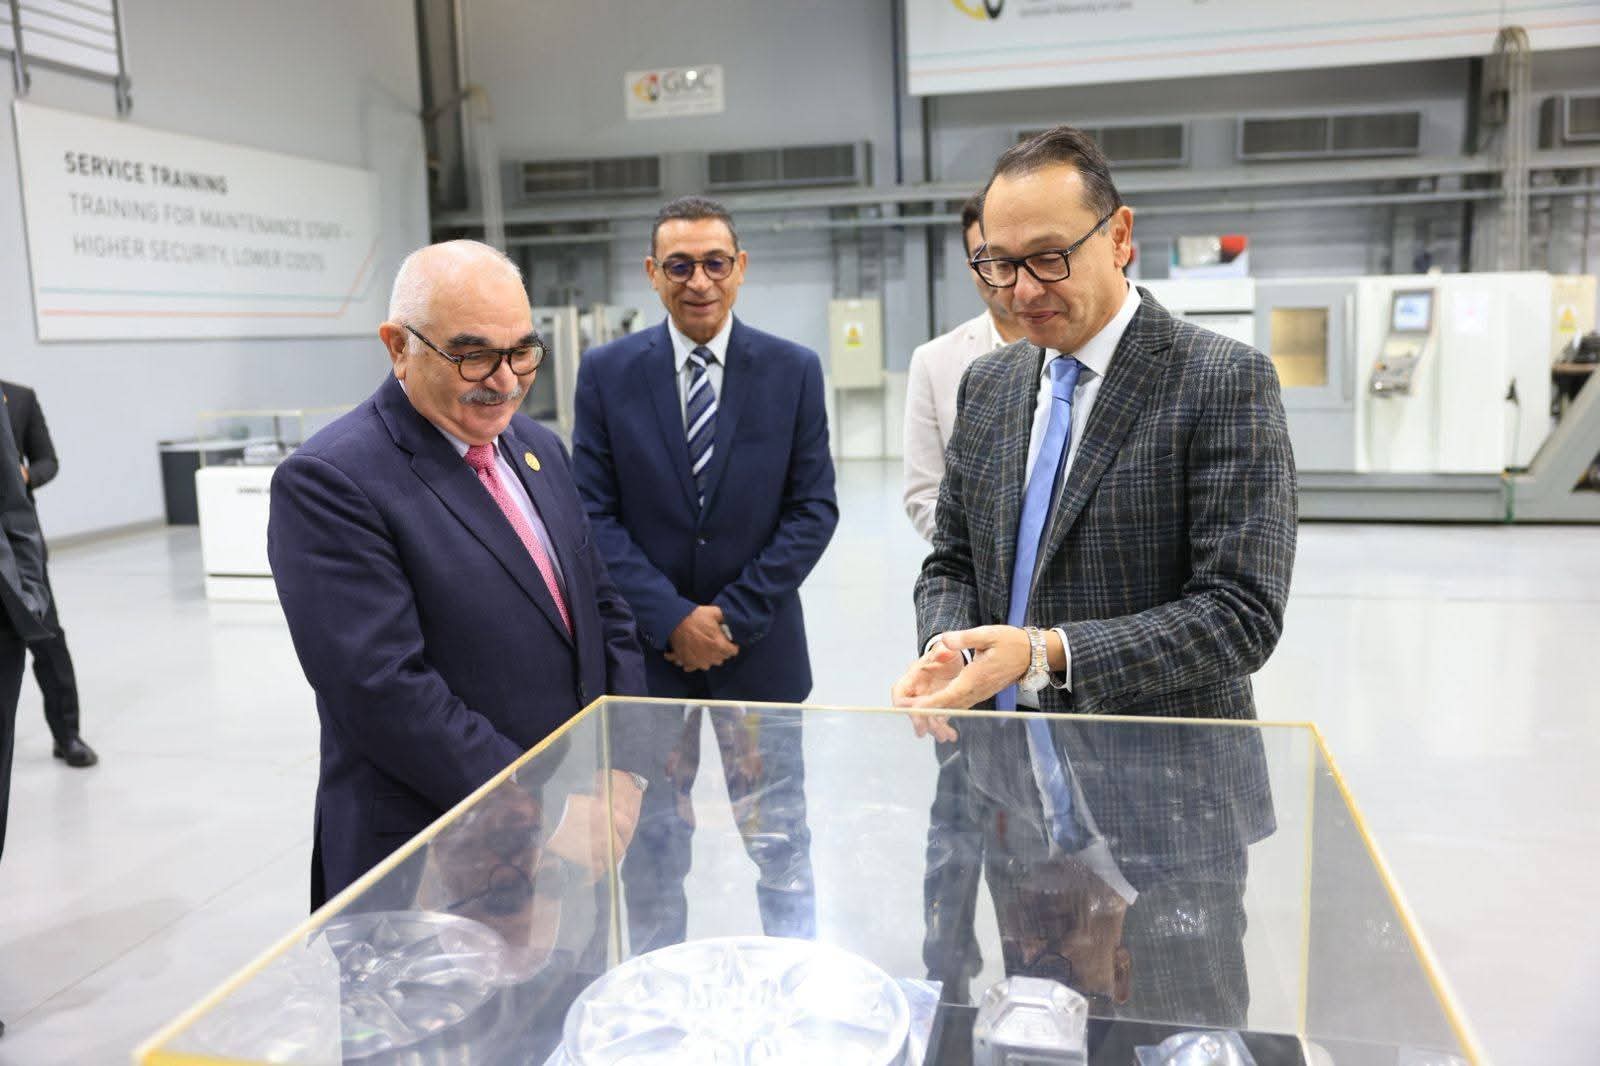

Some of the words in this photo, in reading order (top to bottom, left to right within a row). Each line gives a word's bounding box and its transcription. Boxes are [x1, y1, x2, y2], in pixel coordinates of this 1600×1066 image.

[64, 151, 145, 184] SERVICE
[150, 165, 229, 195] TRAINING
[70, 193, 159, 224] TRAINING
[164, 205, 196, 228] FOR
[201, 209, 302, 239] MAINTENANCE
[73, 234, 146, 261] HIGHER
[232, 246, 281, 271] LOWER
